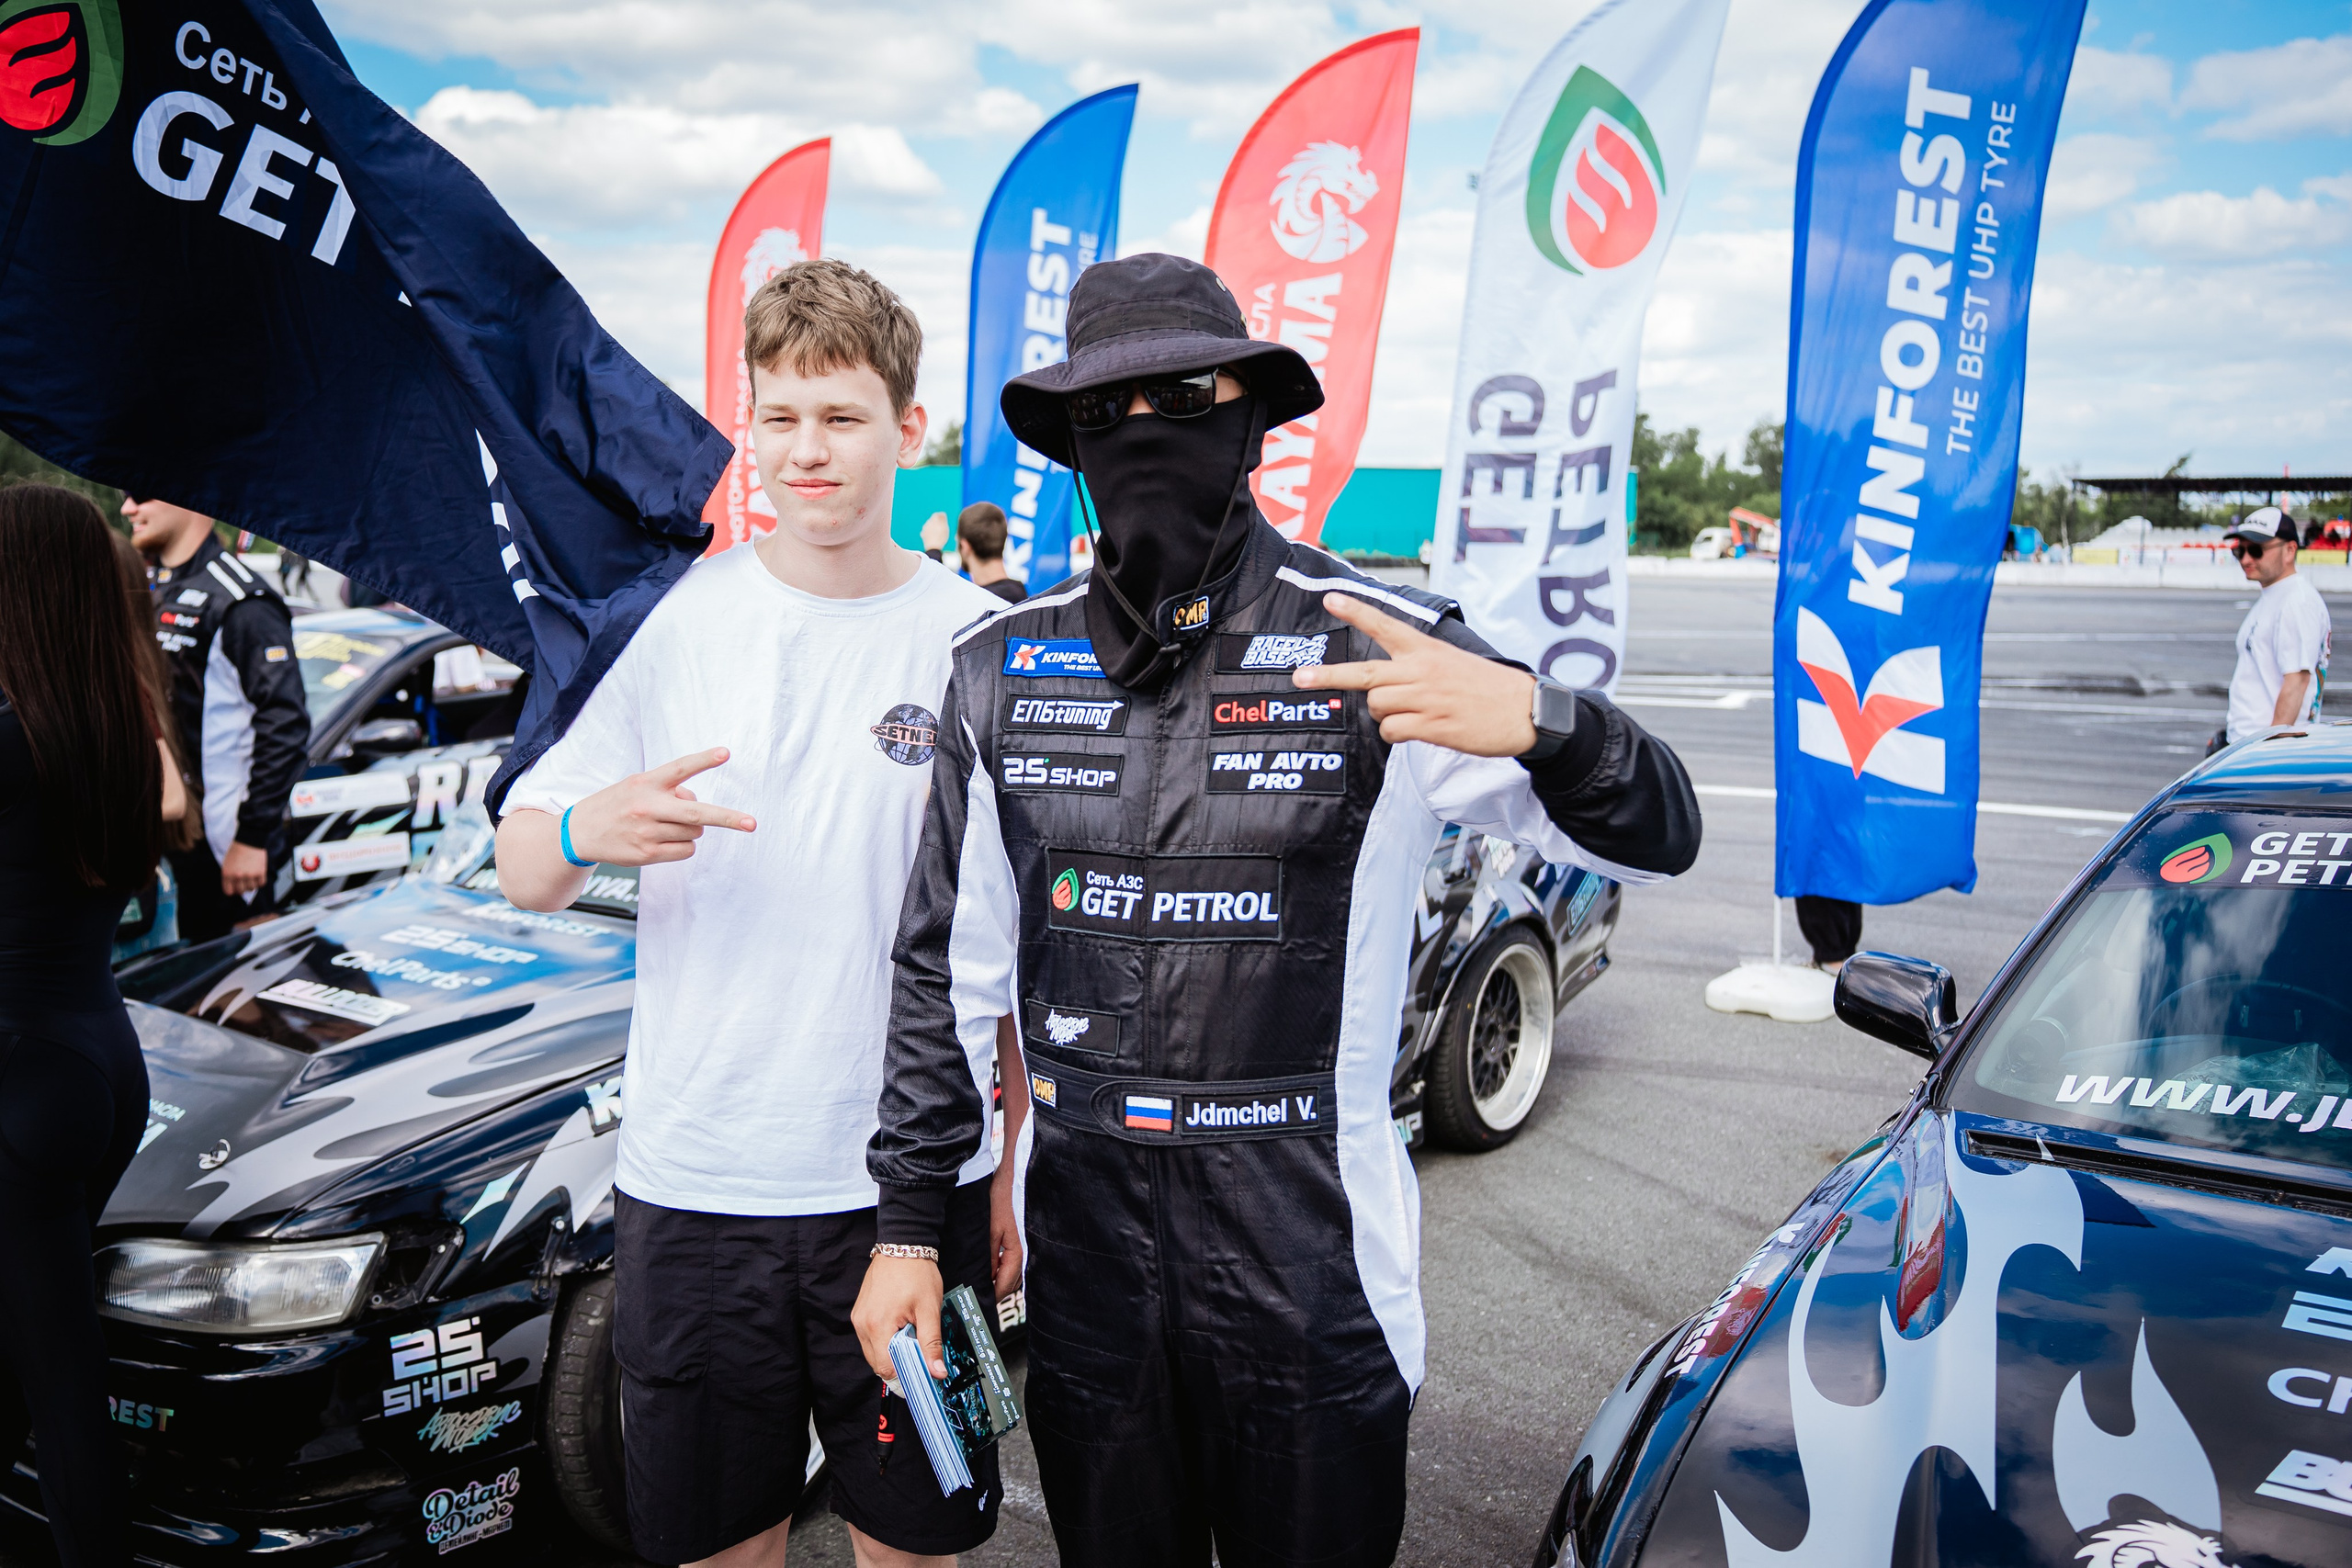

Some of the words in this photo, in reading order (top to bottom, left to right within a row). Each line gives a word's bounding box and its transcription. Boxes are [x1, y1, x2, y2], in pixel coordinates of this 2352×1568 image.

[175, 20, 288, 111] Сеть
[1980, 100, 2018, 193] TYRE
[1968, 201, 2001, 281] UHP
[1847, 66, 1973, 615] KINFOREST
[1956, 287, 1991, 380] BEST
[1946, 387, 1980, 457] THE
[1214, 700, 1330, 723] ChelParts
[1212, 753, 1263, 770] FAN
[1270, 752, 1343, 770] AVTO
[1247, 773, 1304, 790] PRO
[2250, 831, 2352, 856] GET
[1086, 871, 1114, 886] Сеть
[1117, 874, 1144, 890] АЗС
[2240, 859, 2352, 886] PET
[1081, 887, 1144, 919] GET
[1151, 891, 1279, 922] PETROL
[1185, 1099, 1288, 1127] Jdmchel
[1295, 1095, 1317, 1121] V.
[382, 1360, 497, 1417] SHOP
[424, 1470, 519, 1523] Detail
